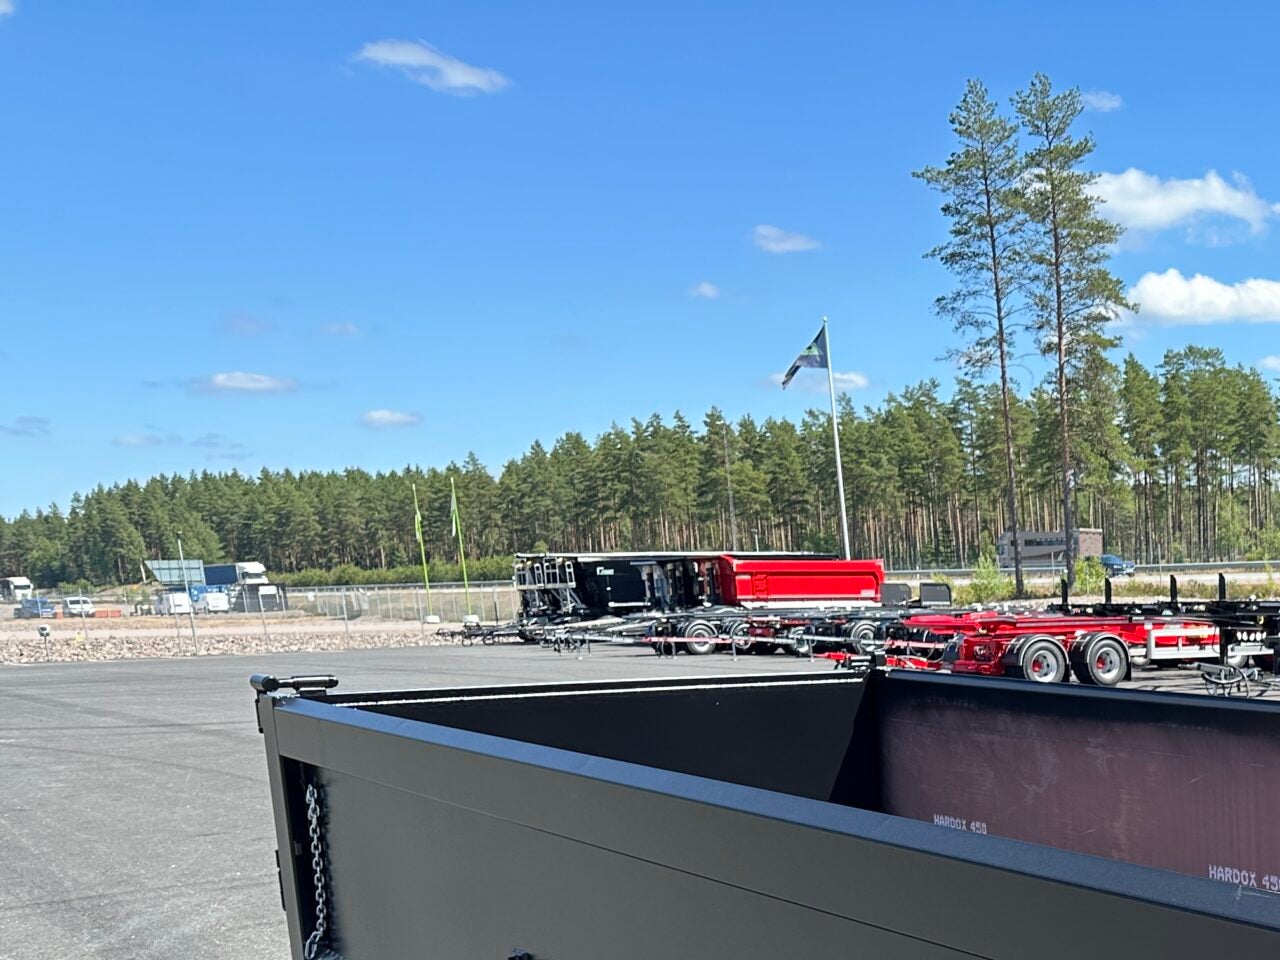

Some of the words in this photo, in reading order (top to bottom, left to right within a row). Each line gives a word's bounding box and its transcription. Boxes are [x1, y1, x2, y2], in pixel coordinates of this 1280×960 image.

[933, 812, 967, 831] HARDOX
[970, 820, 987, 835] 450
[1208, 863, 1257, 887] HARDOX
